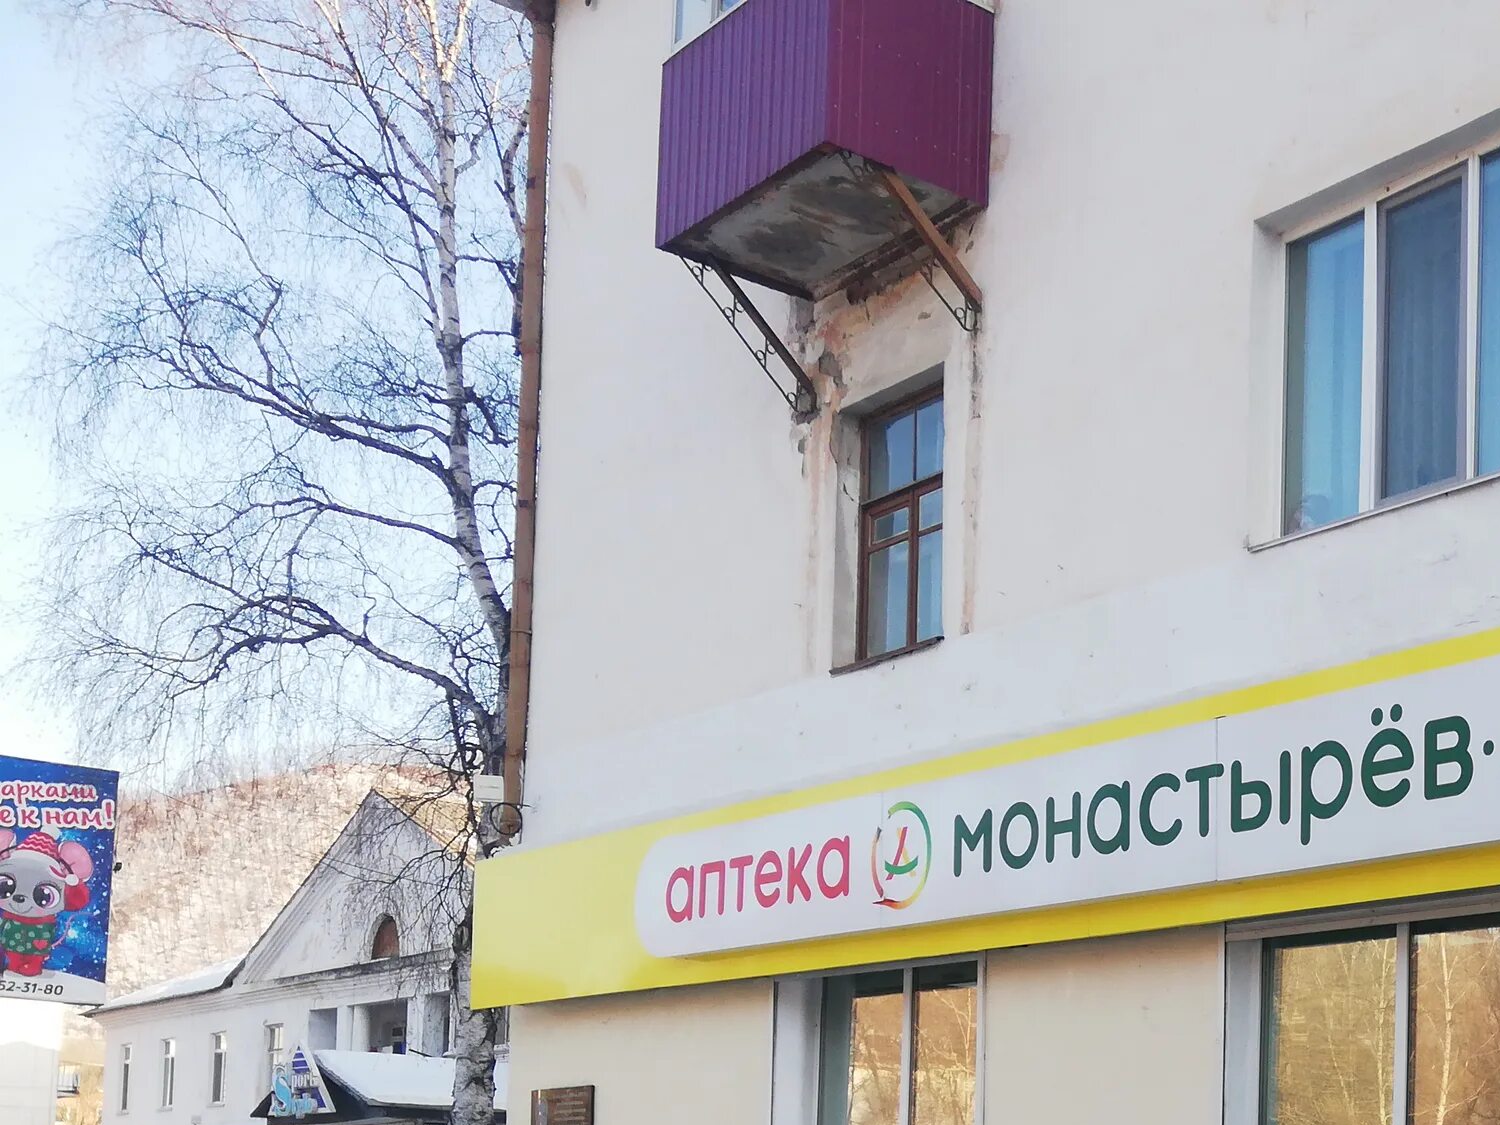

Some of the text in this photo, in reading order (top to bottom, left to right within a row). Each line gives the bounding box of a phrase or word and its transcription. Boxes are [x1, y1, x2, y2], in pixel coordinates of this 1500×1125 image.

[1, 783, 96, 804] арками
[21, 809, 37, 825] к
[45, 802, 114, 826] нам!
[665, 834, 851, 924] аптека
[0, 980, 64, 996] 52-31-80
